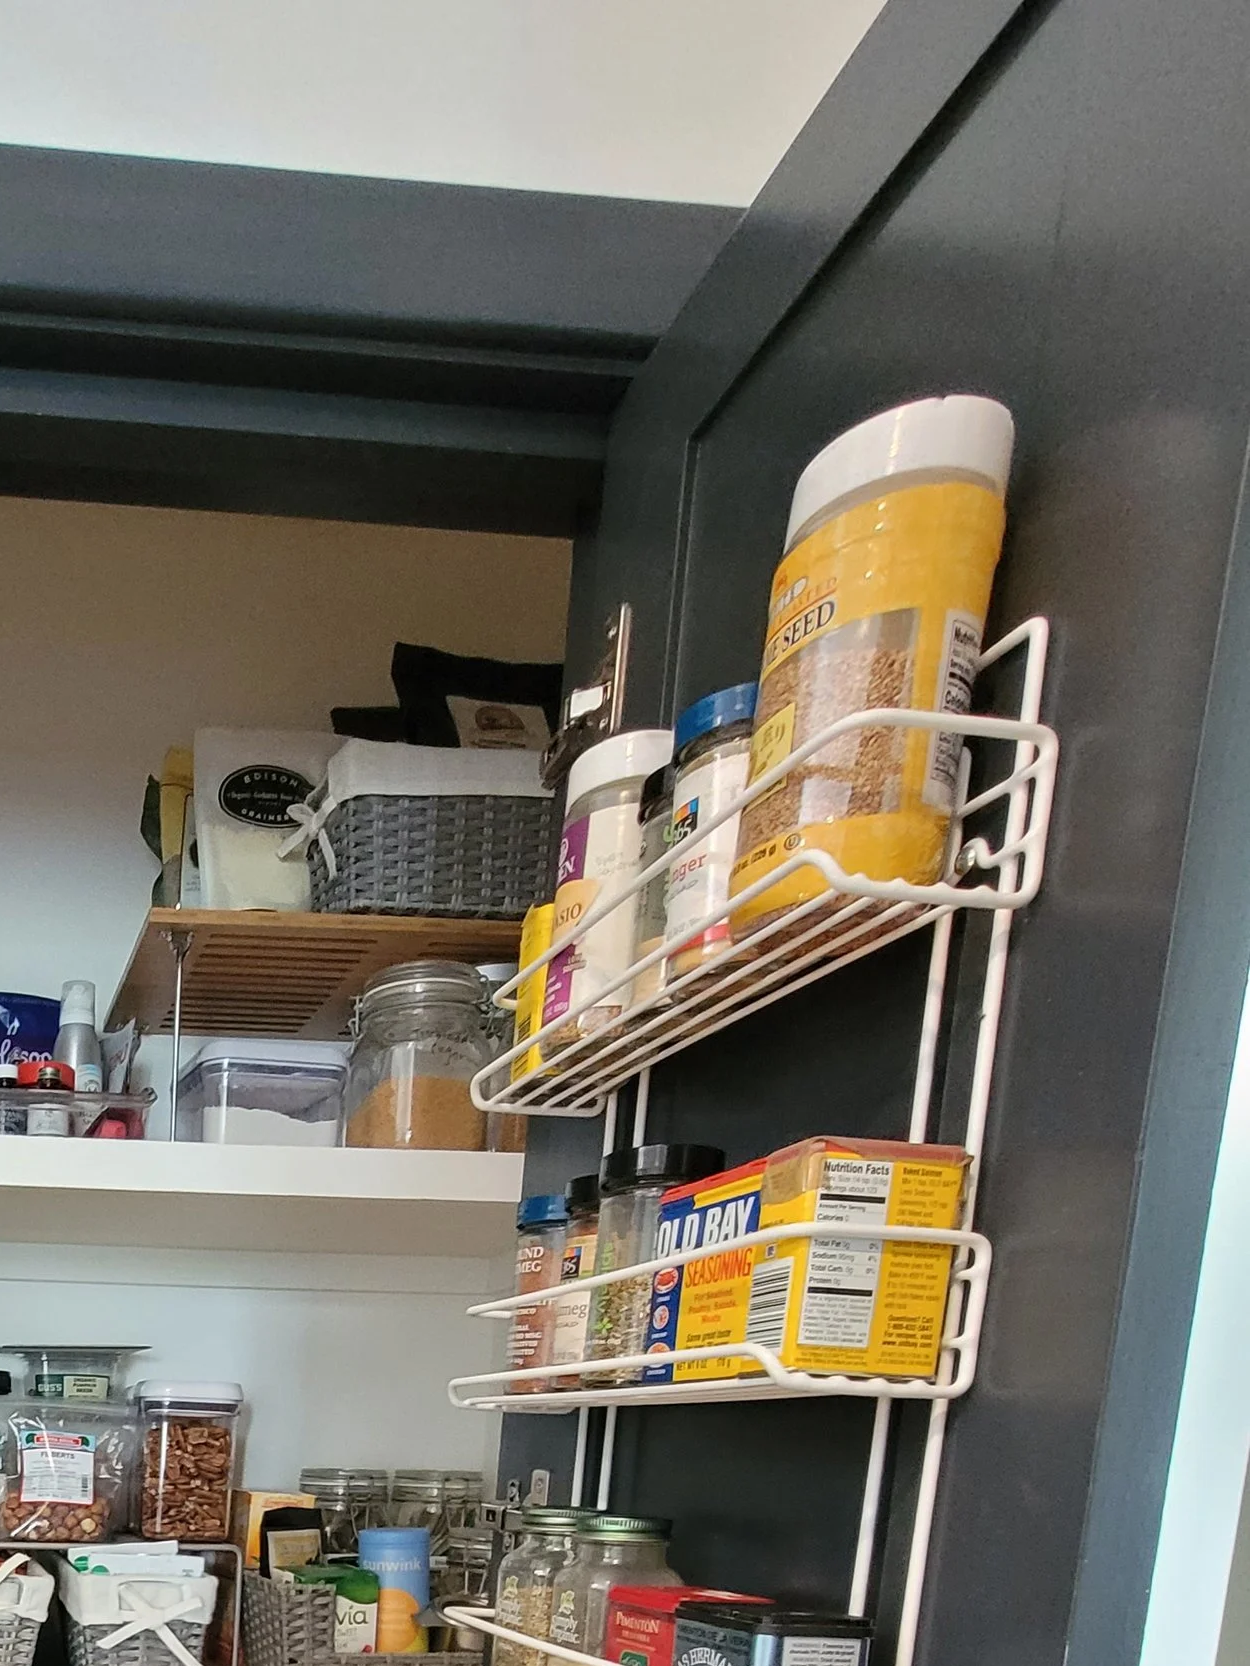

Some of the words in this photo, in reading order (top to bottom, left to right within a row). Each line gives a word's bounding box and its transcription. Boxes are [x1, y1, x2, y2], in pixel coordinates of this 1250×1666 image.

[782, 599, 836, 654] SEED
[244, 772, 298, 788] EDISON
[823, 1161, 864, 1176] Nutrition
[865, 1163, 890, 1176] Facts
[817, 1213, 843, 1222] Calories
[657, 1212, 700, 1262] OLD
[702, 1196, 756, 1247] BAY
[814, 1239, 830, 1248] Total
[830, 1240, 841, 1249] Fat
[812, 1250, 838, 1261] Sodium
[685, 1247, 754, 1289] SEASONING
[810, 1263, 827, 1273] Total
[808, 1276, 832, 1286] Protein
[363, 1559, 422, 1573] sunwink
